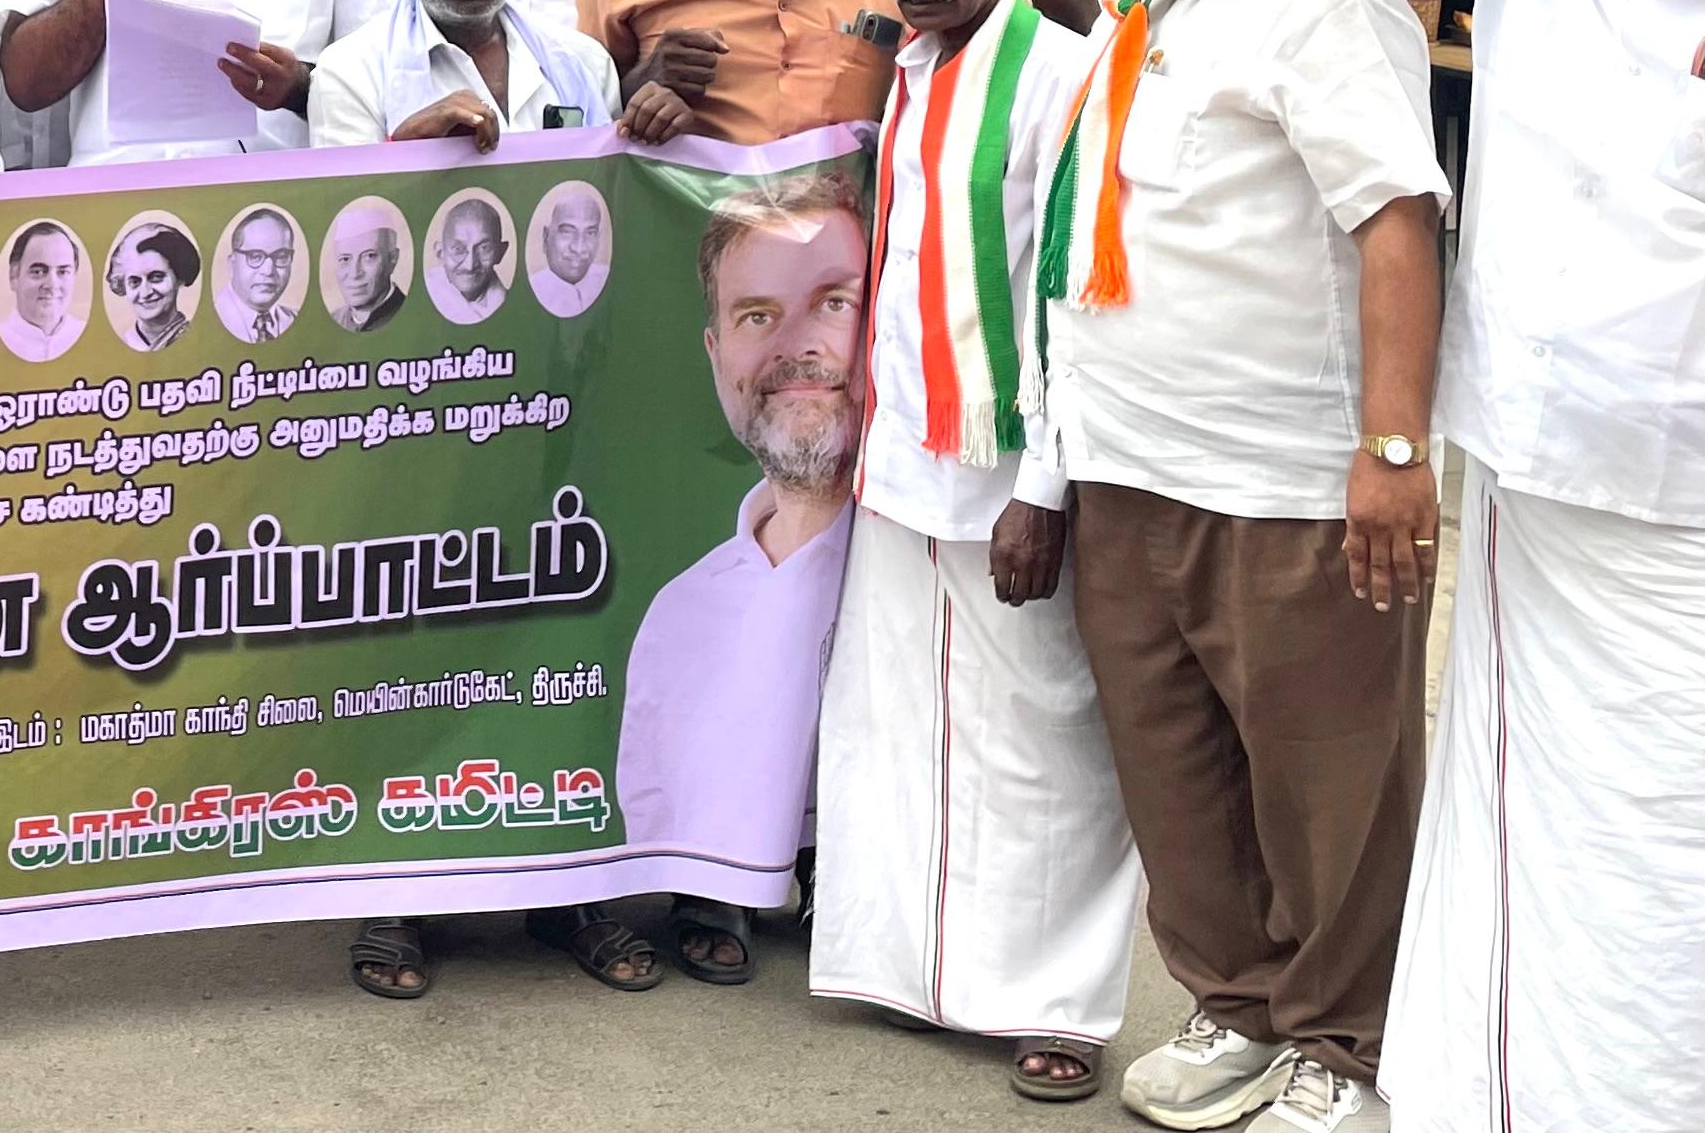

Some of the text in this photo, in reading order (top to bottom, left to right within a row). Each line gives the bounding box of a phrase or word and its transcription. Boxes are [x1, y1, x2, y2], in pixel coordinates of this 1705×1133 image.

[139, 369, 222, 416] பதவி
[229, 358, 368, 409] நீட்டிப்பை
[376, 346, 514, 395] வழங்கிய
[45, 419, 261, 478] நடத்துவதற்கு
[268, 403, 436, 458] அனுமதிக்க
[444, 392, 570, 443] மறுக்கிற
[19, 479, 173, 525] கண்டித்து
[62, 486, 606, 669] ஆர்ப்பாட்டம்
[80, 702, 177, 745] மகாத்மா
[184, 695, 250, 736] காந்தி
[256, 694, 324, 728] சிலை,
[333, 669, 523, 719] மெயின்கார்டுகேட்,
[531, 661, 608, 706] திருச்சி.
[8, 766, 358, 870] காங்கிரஸ்
[378, 758, 610, 833] கமிட்டி
